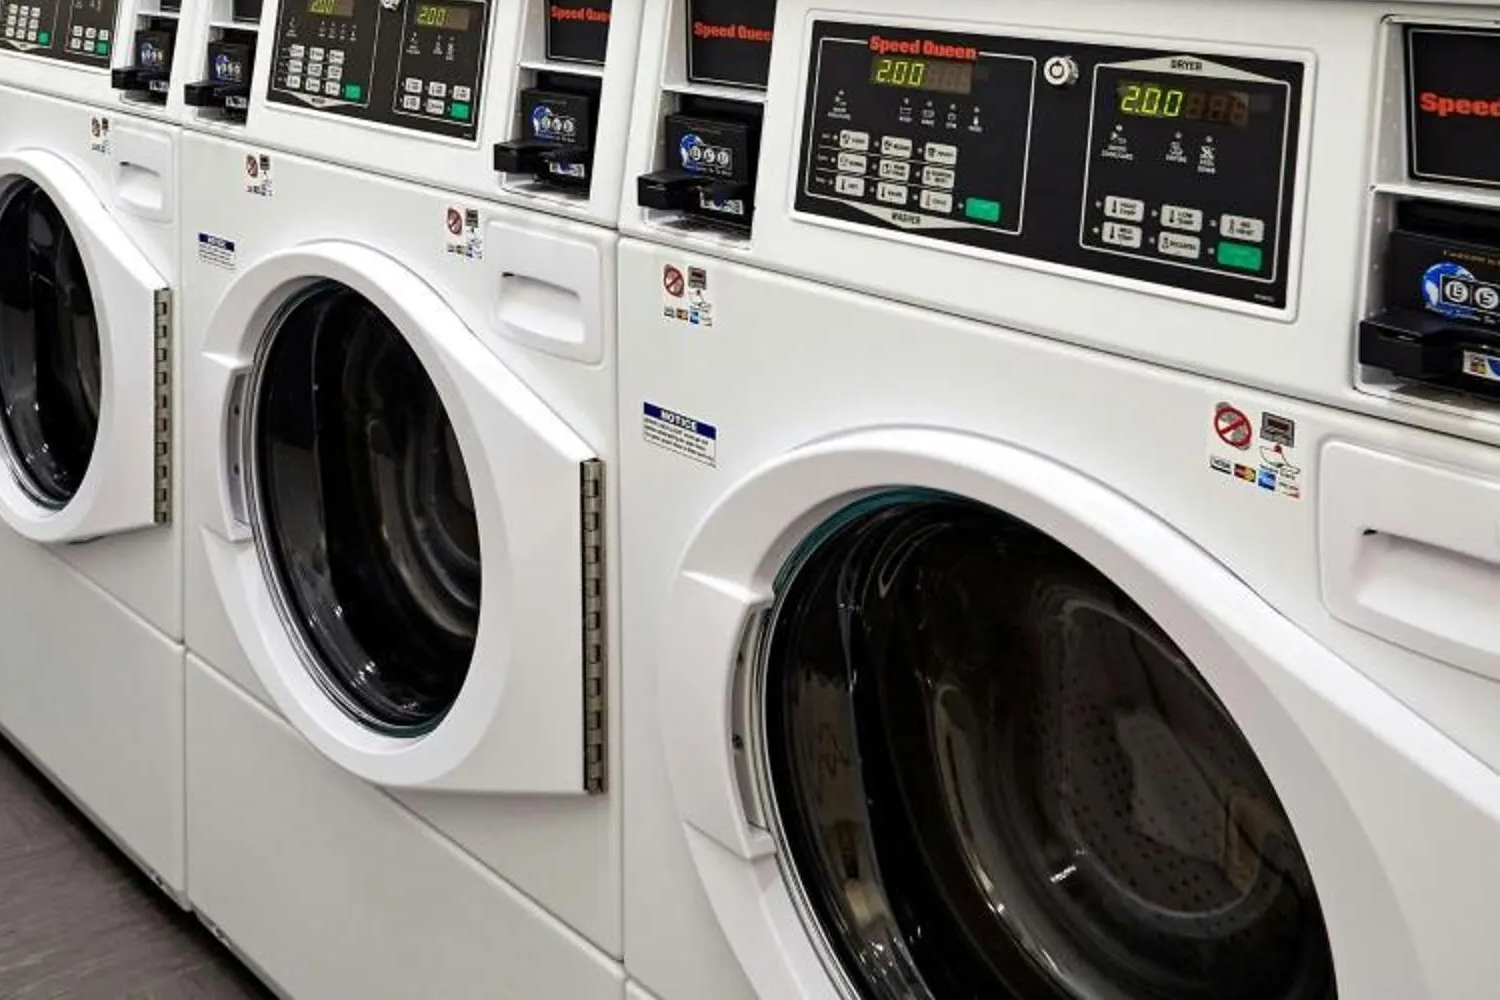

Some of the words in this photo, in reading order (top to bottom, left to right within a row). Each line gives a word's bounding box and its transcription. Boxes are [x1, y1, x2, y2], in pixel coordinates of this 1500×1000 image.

[551, 5, 584, 22] Speed
[693, 21, 736, 39] Speed
[869, 36, 921, 54] Speed
[923, 41, 977, 60] Queen
[876, 58, 925, 87] 2.00
[1171, 59, 1203, 72] DRYER
[1120, 84, 1184, 118] 2.00
[660, 409, 698, 432] NOTICE
